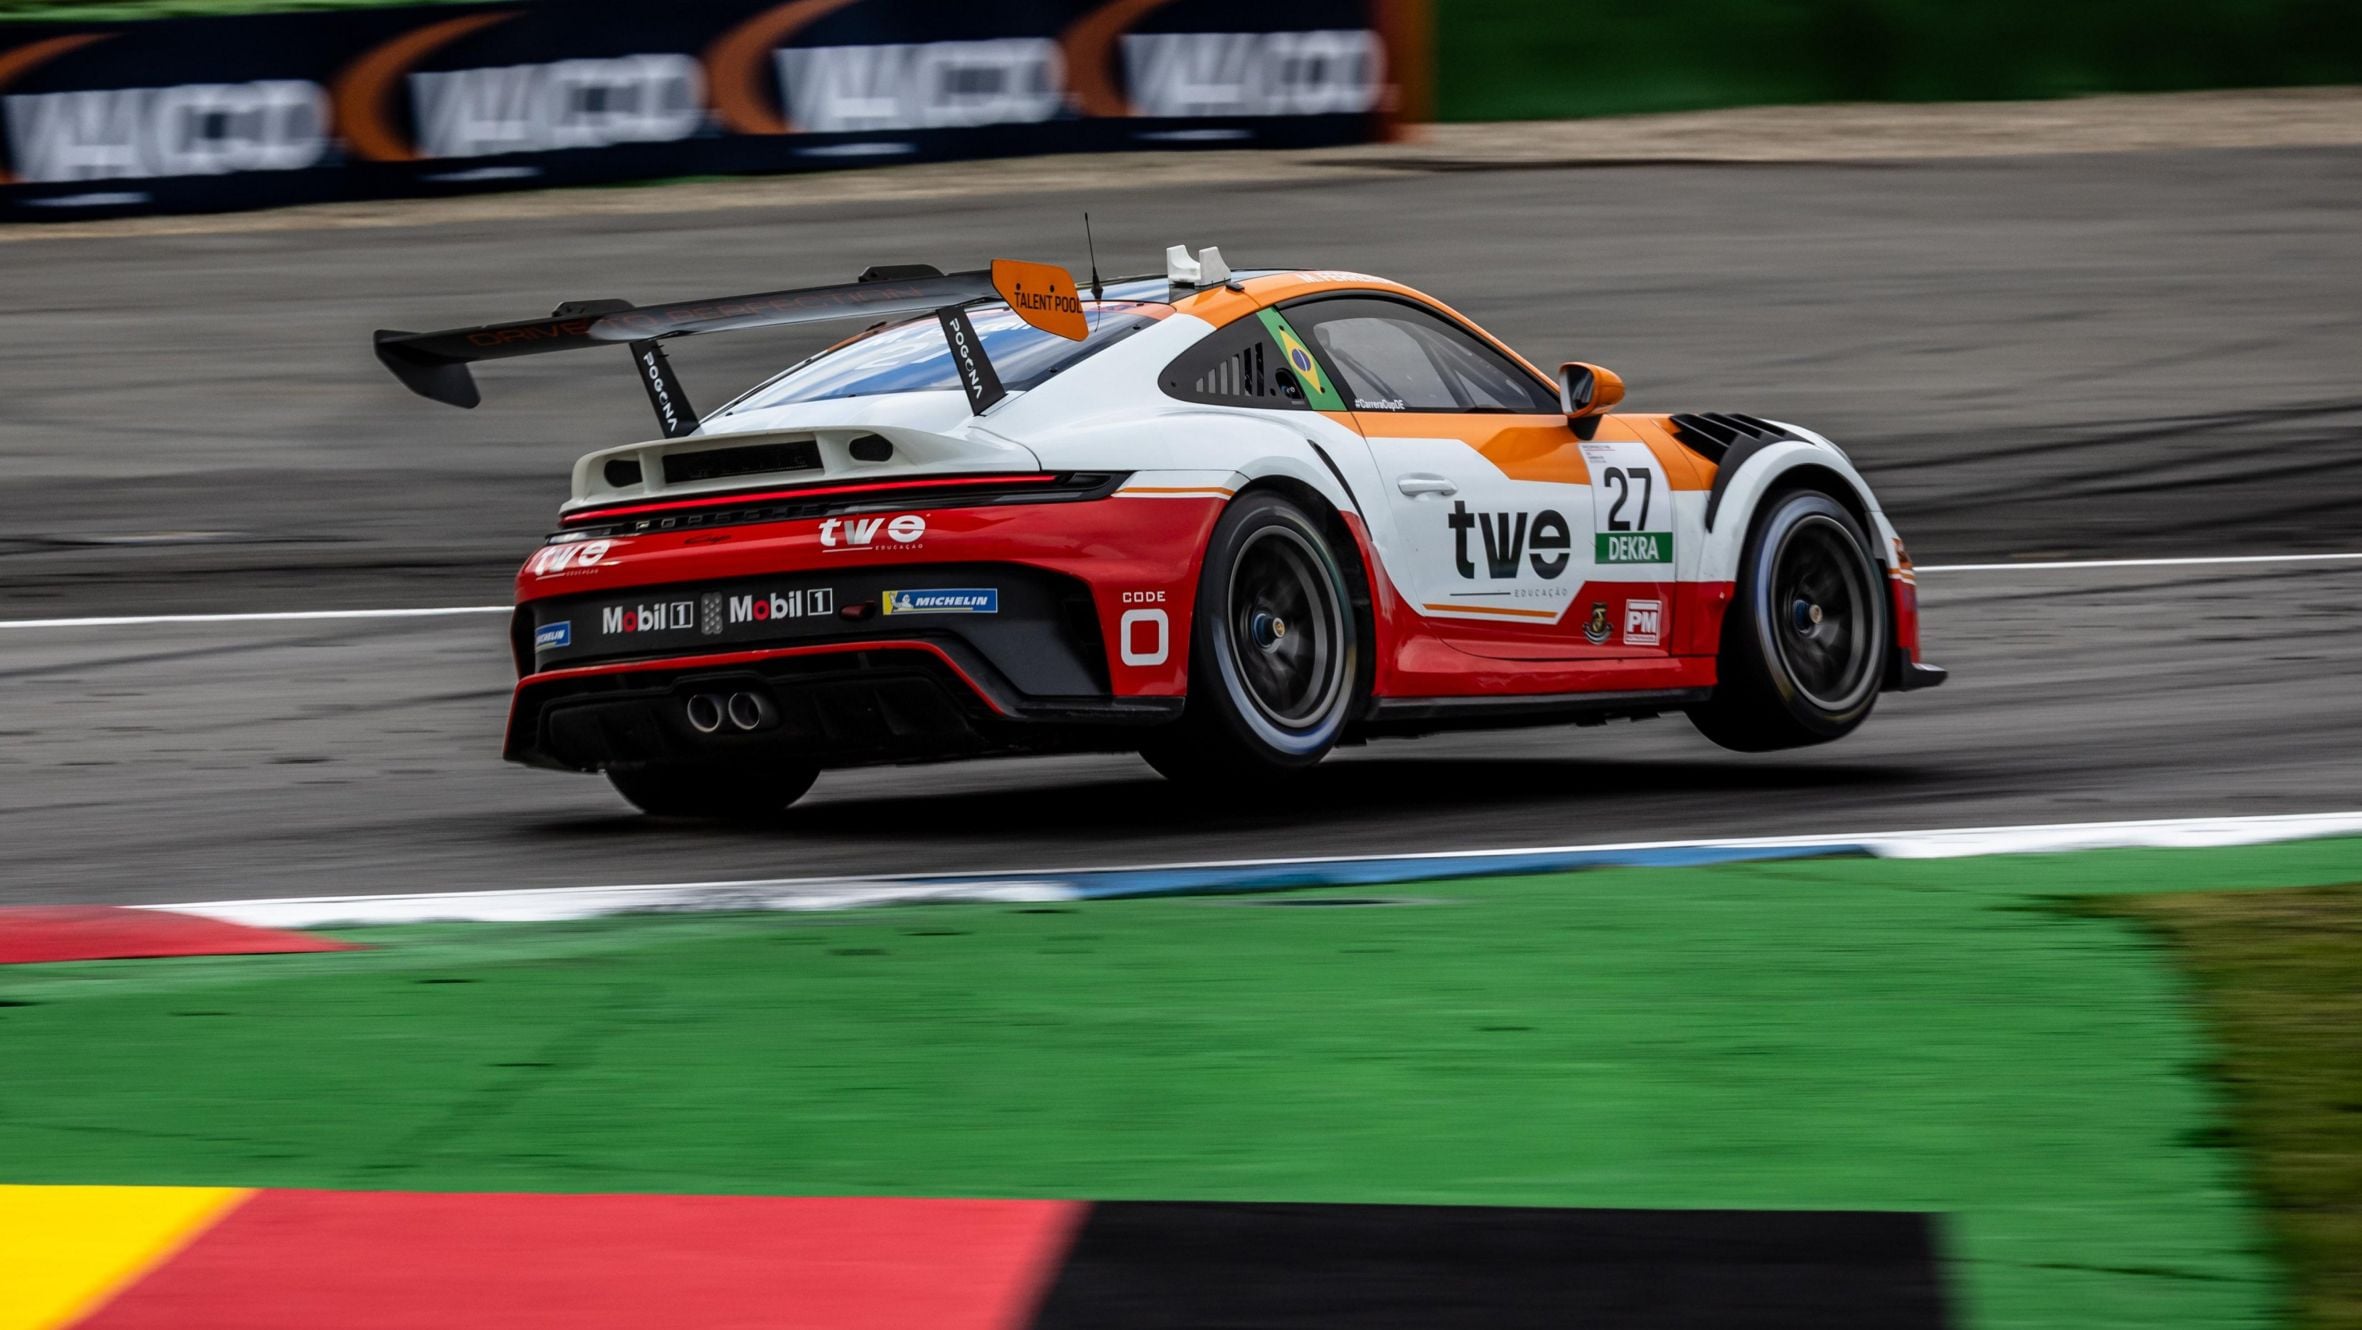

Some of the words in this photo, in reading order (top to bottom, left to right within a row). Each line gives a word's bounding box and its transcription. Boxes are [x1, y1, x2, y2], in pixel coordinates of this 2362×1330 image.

[1014, 292, 1053, 311] TALENT
[1604, 466, 1652, 531] 27
[818, 514, 926, 547] twe
[1448, 500, 1571, 580] twe
[1608, 535, 1660, 561] DEKRA
[729, 591, 802, 623] Mobil
[915, 596, 988, 607] MICHELIN
[1122, 590, 1166, 603] CODE
[602, 603, 666, 634] Mobil
[1627, 610, 1658, 633] PM
